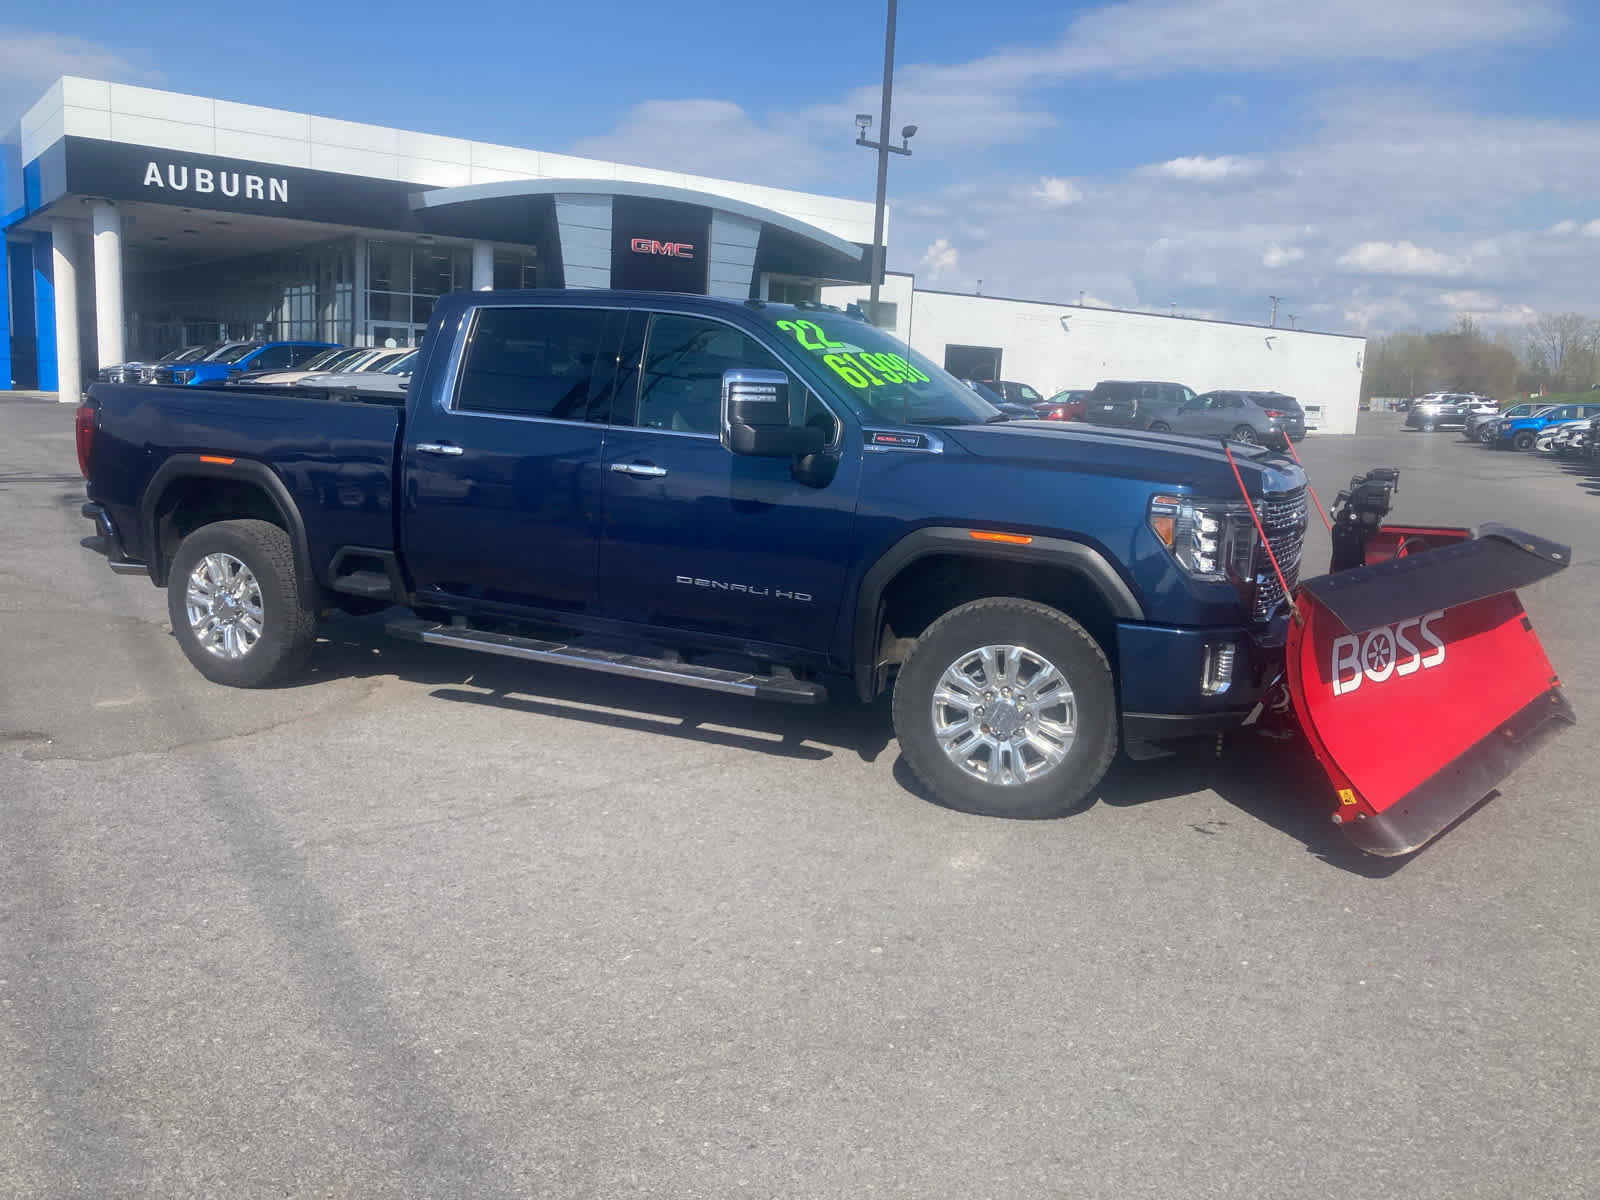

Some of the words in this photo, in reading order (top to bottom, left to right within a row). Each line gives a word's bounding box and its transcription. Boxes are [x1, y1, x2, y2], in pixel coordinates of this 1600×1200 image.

[143, 161, 289, 203] AUBURN
[631, 238, 694, 259] GMC
[776, 319, 844, 351] 22
[675, 575, 769, 597] DENALI
[775, 589, 813, 602] HD
[1332, 608, 1446, 697] BOSS
